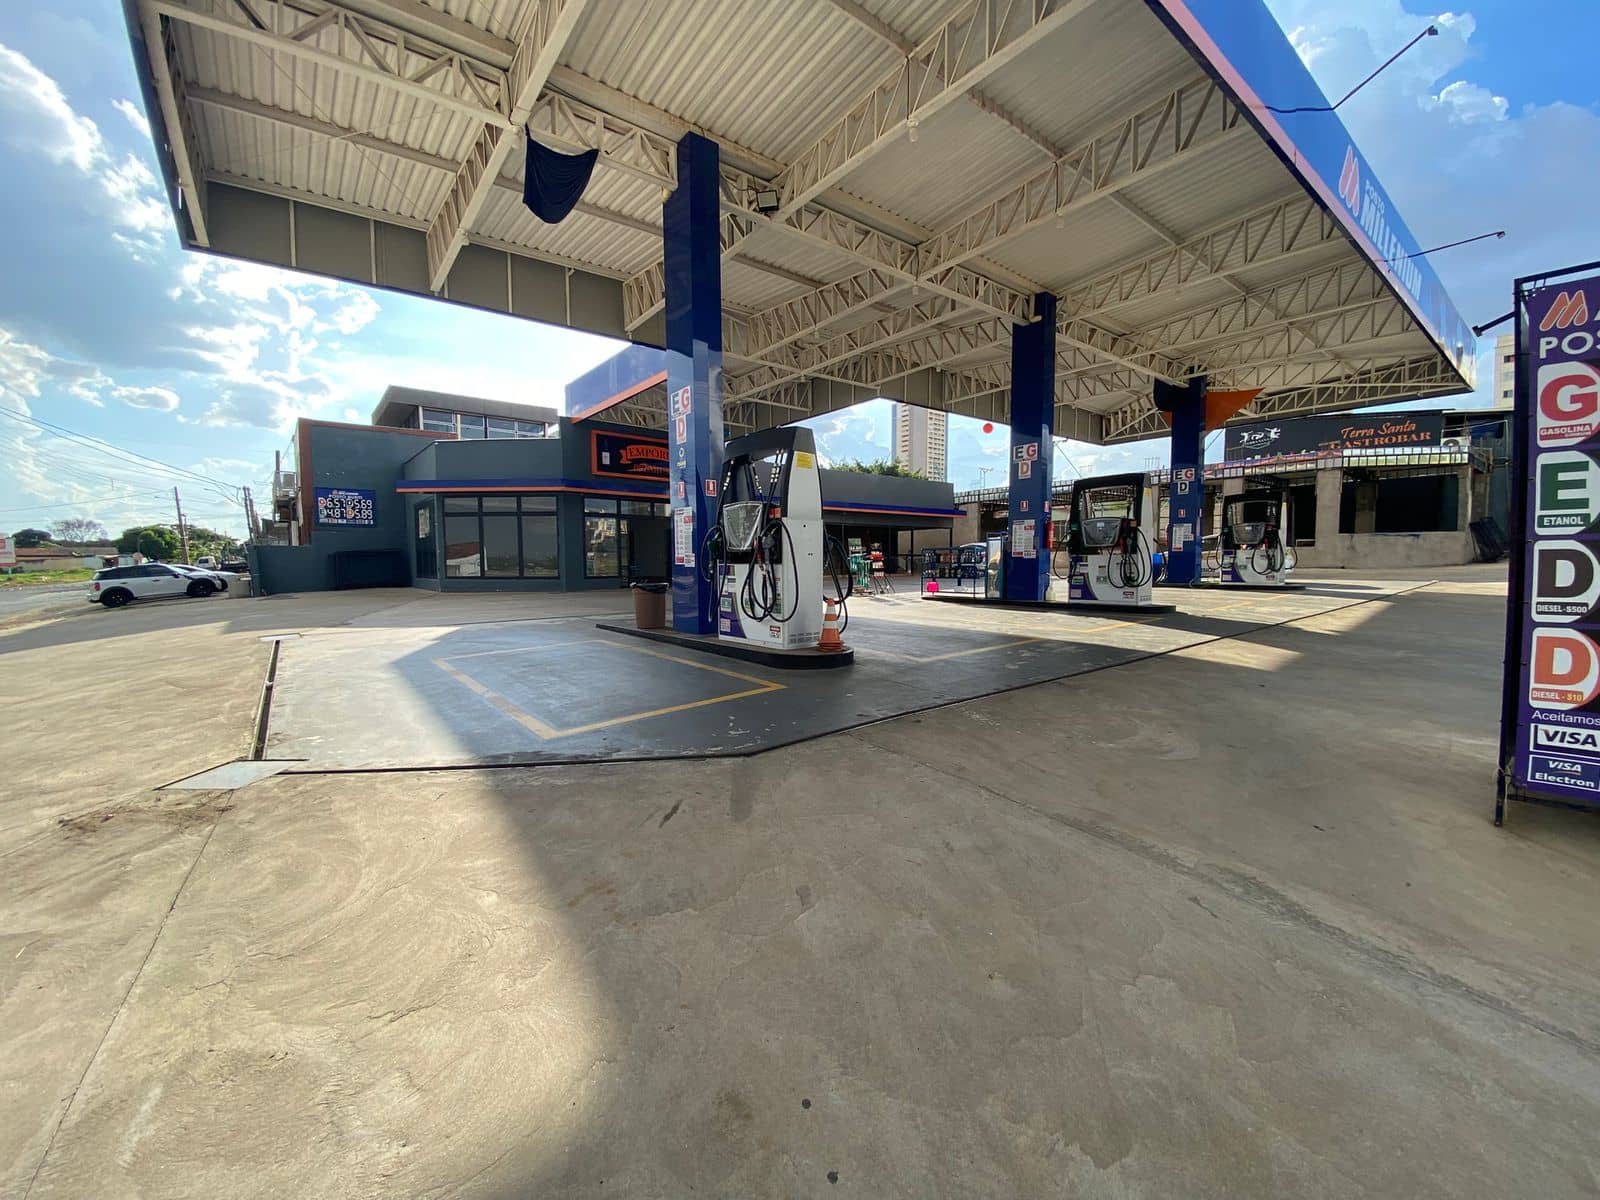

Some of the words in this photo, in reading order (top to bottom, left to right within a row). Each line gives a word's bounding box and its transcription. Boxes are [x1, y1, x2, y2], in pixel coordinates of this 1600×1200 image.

[1360, 190, 1422, 301] MILLENIUM
[1539, 331, 1600, 360] PO
[1539, 373, 1598, 422] G
[1341, 426, 1375, 439] Terra
[1377, 420, 1416, 435] Santa
[1540, 425, 1591, 436] GASOLINA
[1539, 460, 1590, 511] E
[1543, 515, 1584, 526] ETANOL
[1536, 547, 1594, 598] D
[1534, 635, 1592, 685] D
[1532, 690, 1560, 700] DIESEL
[1532, 710, 1600, 726] Aceitamos
[1541, 727, 1598, 747] VISA
[1548, 760, 1582, 772] VISA
[1535, 772, 1595, 788] Electron
